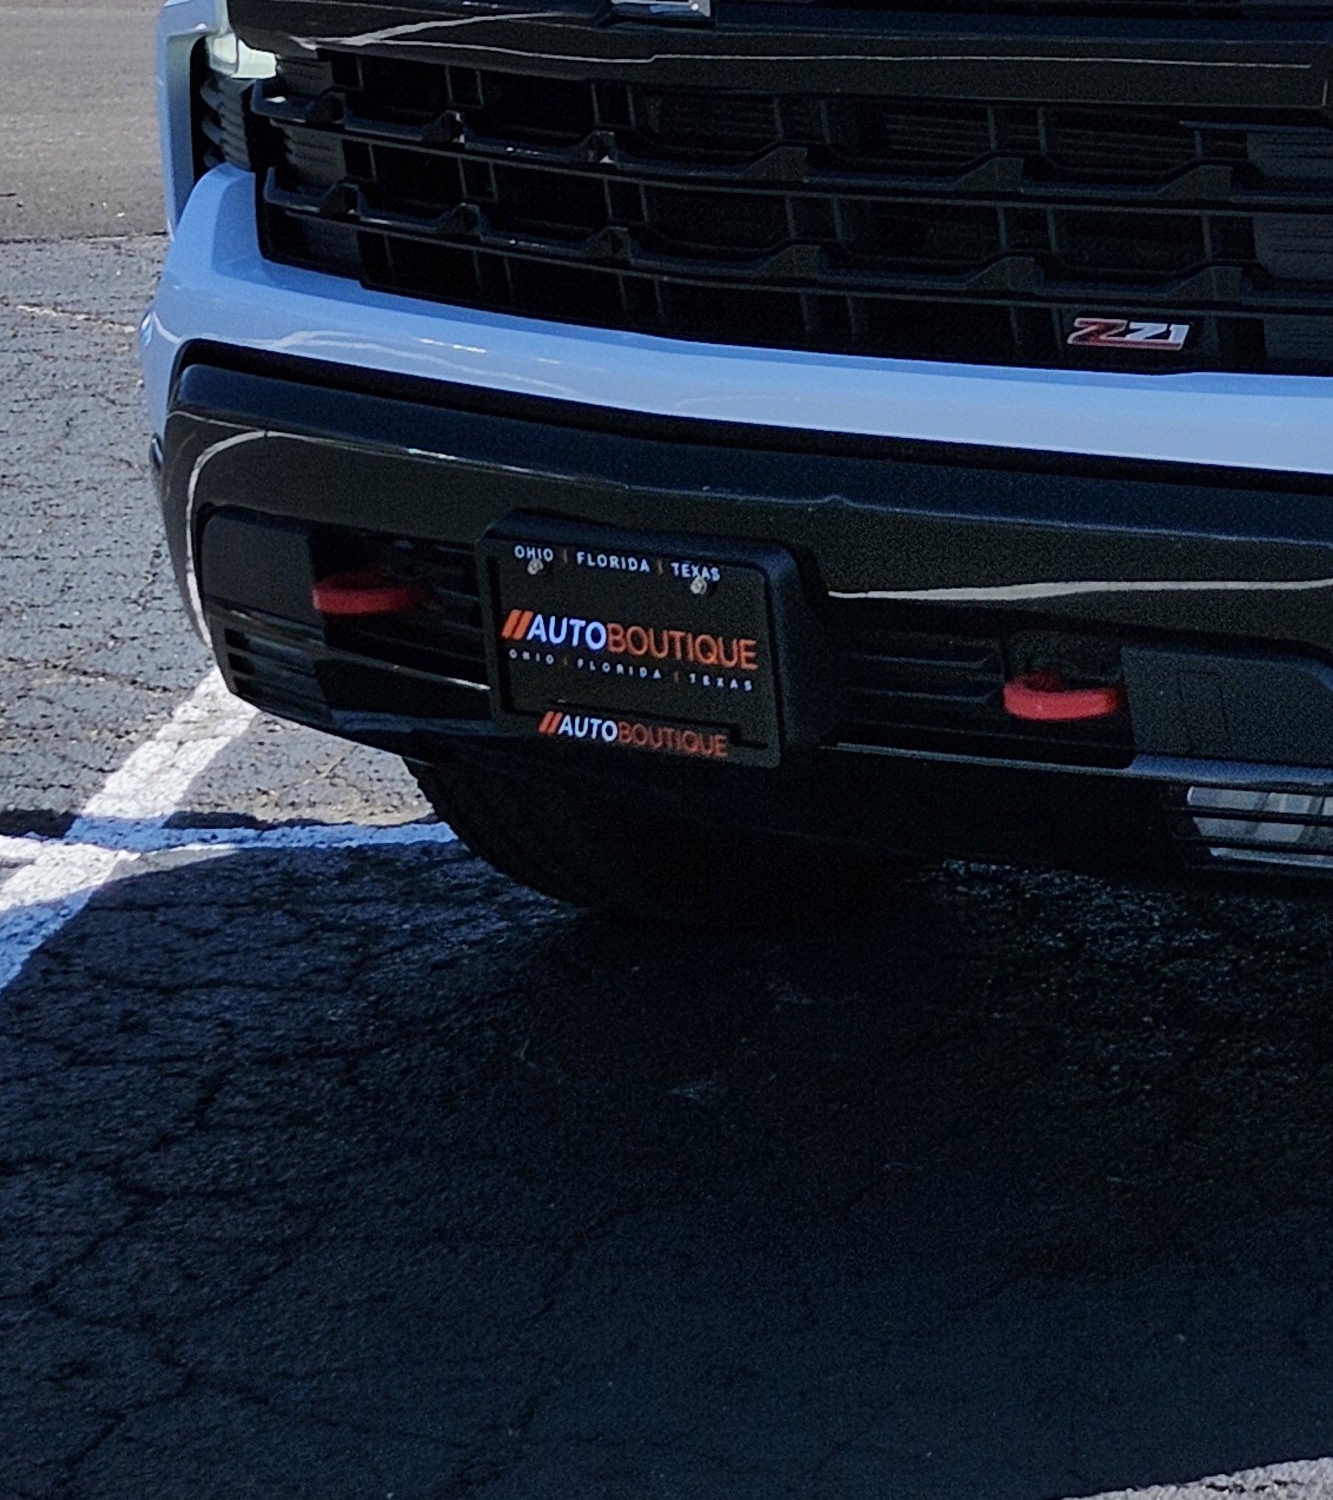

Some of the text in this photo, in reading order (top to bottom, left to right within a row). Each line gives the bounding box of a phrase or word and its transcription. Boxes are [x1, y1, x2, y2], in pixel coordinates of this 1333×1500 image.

[1066, 317, 1191, 351] Z71
[513, 544, 721, 582] OHIO FLORIDA TEXAS
[508, 648, 753, 692] OHIO FLORIDA TEXAS
